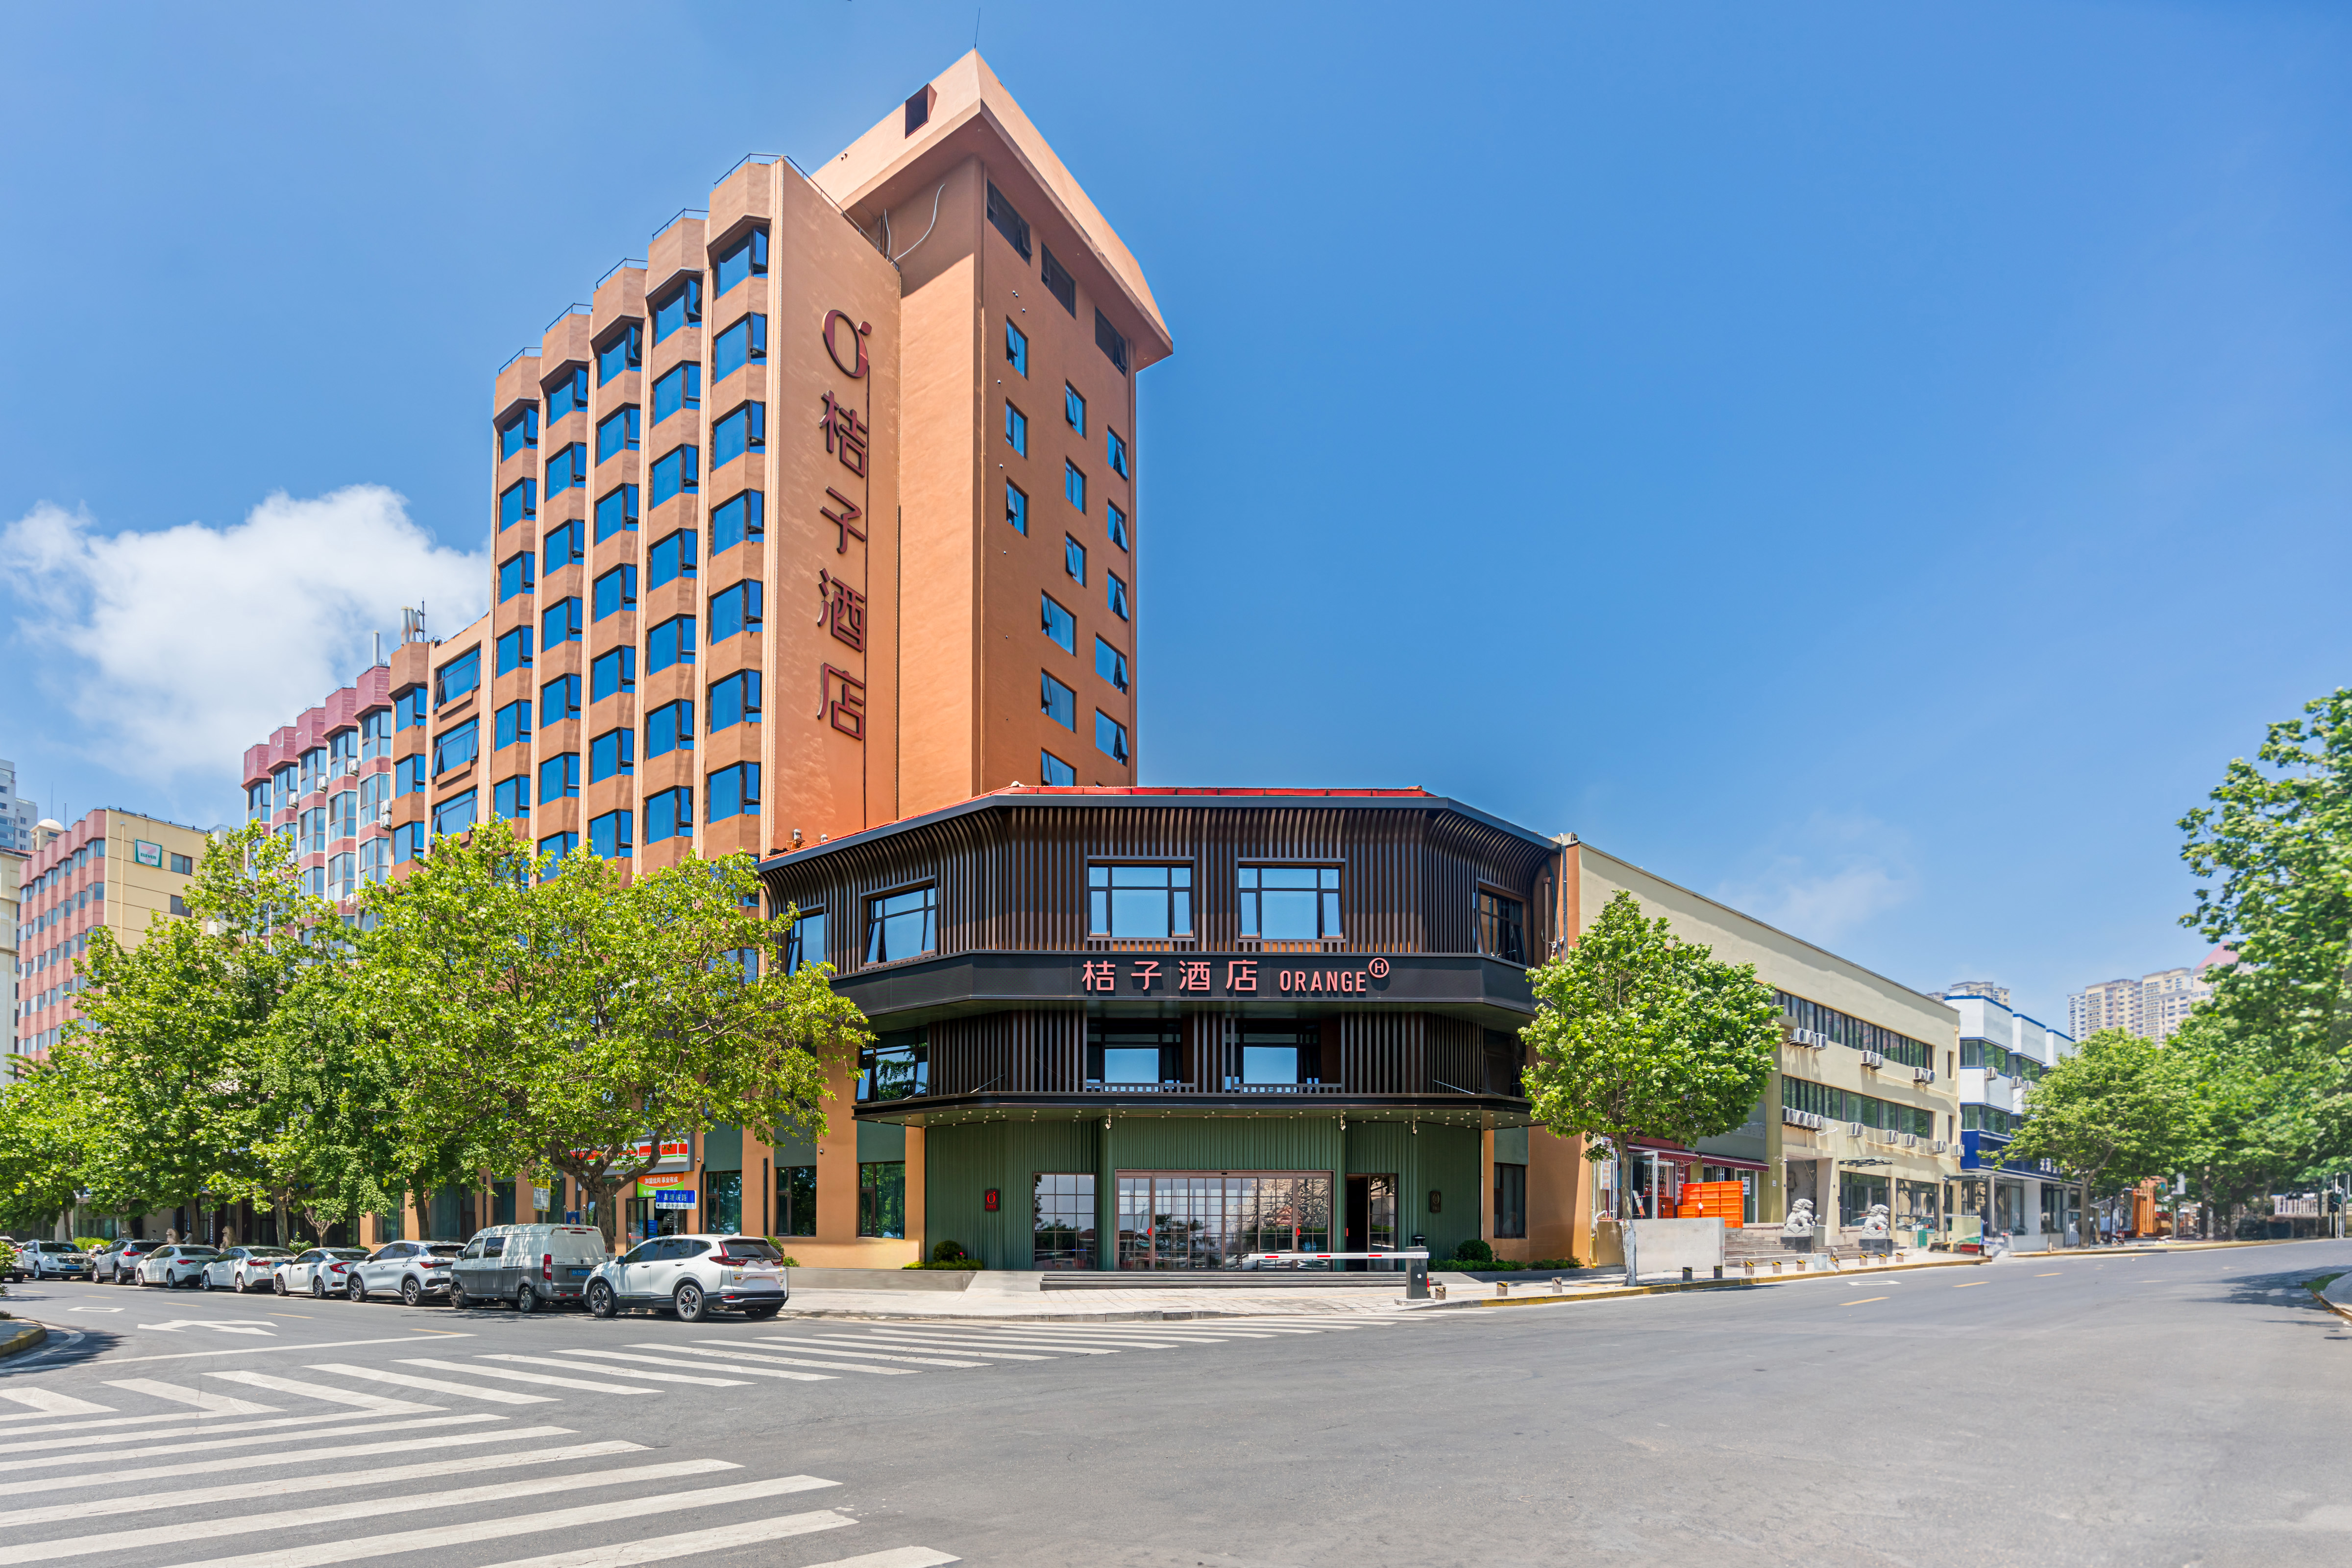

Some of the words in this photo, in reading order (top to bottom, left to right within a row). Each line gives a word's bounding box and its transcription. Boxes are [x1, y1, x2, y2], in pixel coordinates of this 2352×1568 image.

[817, 390, 868, 741] 桔子酒店
[1082, 959, 1258, 991] 桔子酒店
[1279, 970, 1366, 992] ORANGE
